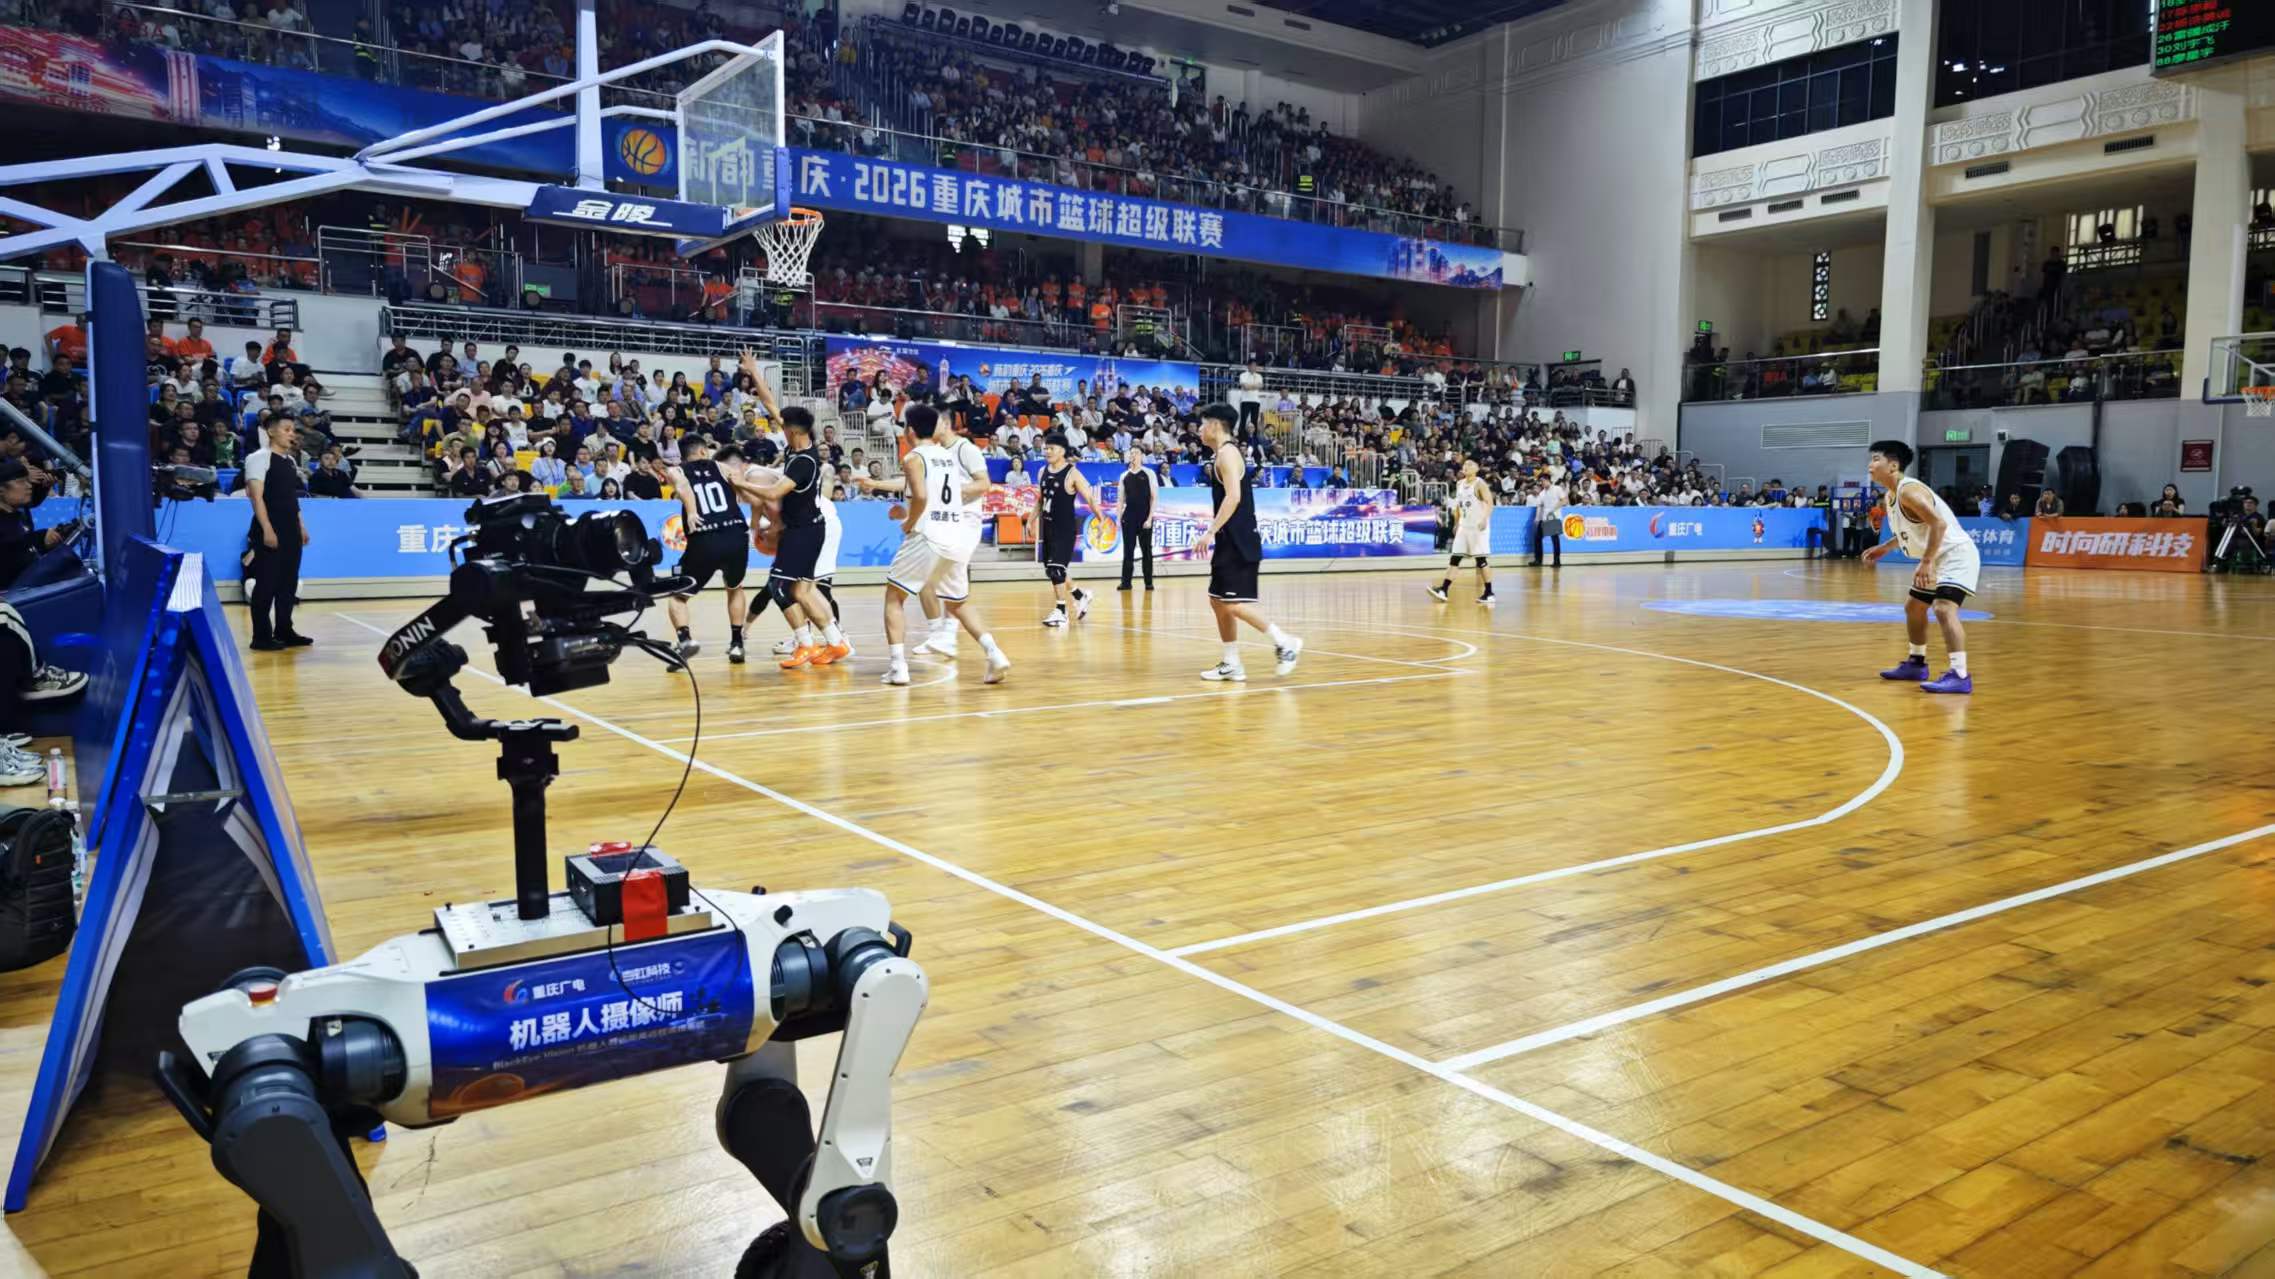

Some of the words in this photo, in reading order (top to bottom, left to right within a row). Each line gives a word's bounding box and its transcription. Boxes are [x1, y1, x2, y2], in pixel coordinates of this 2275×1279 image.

[572, 199, 657, 223] 金陵
[693, 481, 728, 515] 10
[941, 473, 952, 505] 6
[2040, 530, 2195, 558] 时向研科技
[388, 615, 437, 660] ONIN
[532, 977, 587, 1000] 重庆广电
[509, 990, 684, 1051] 机器人摄像师
